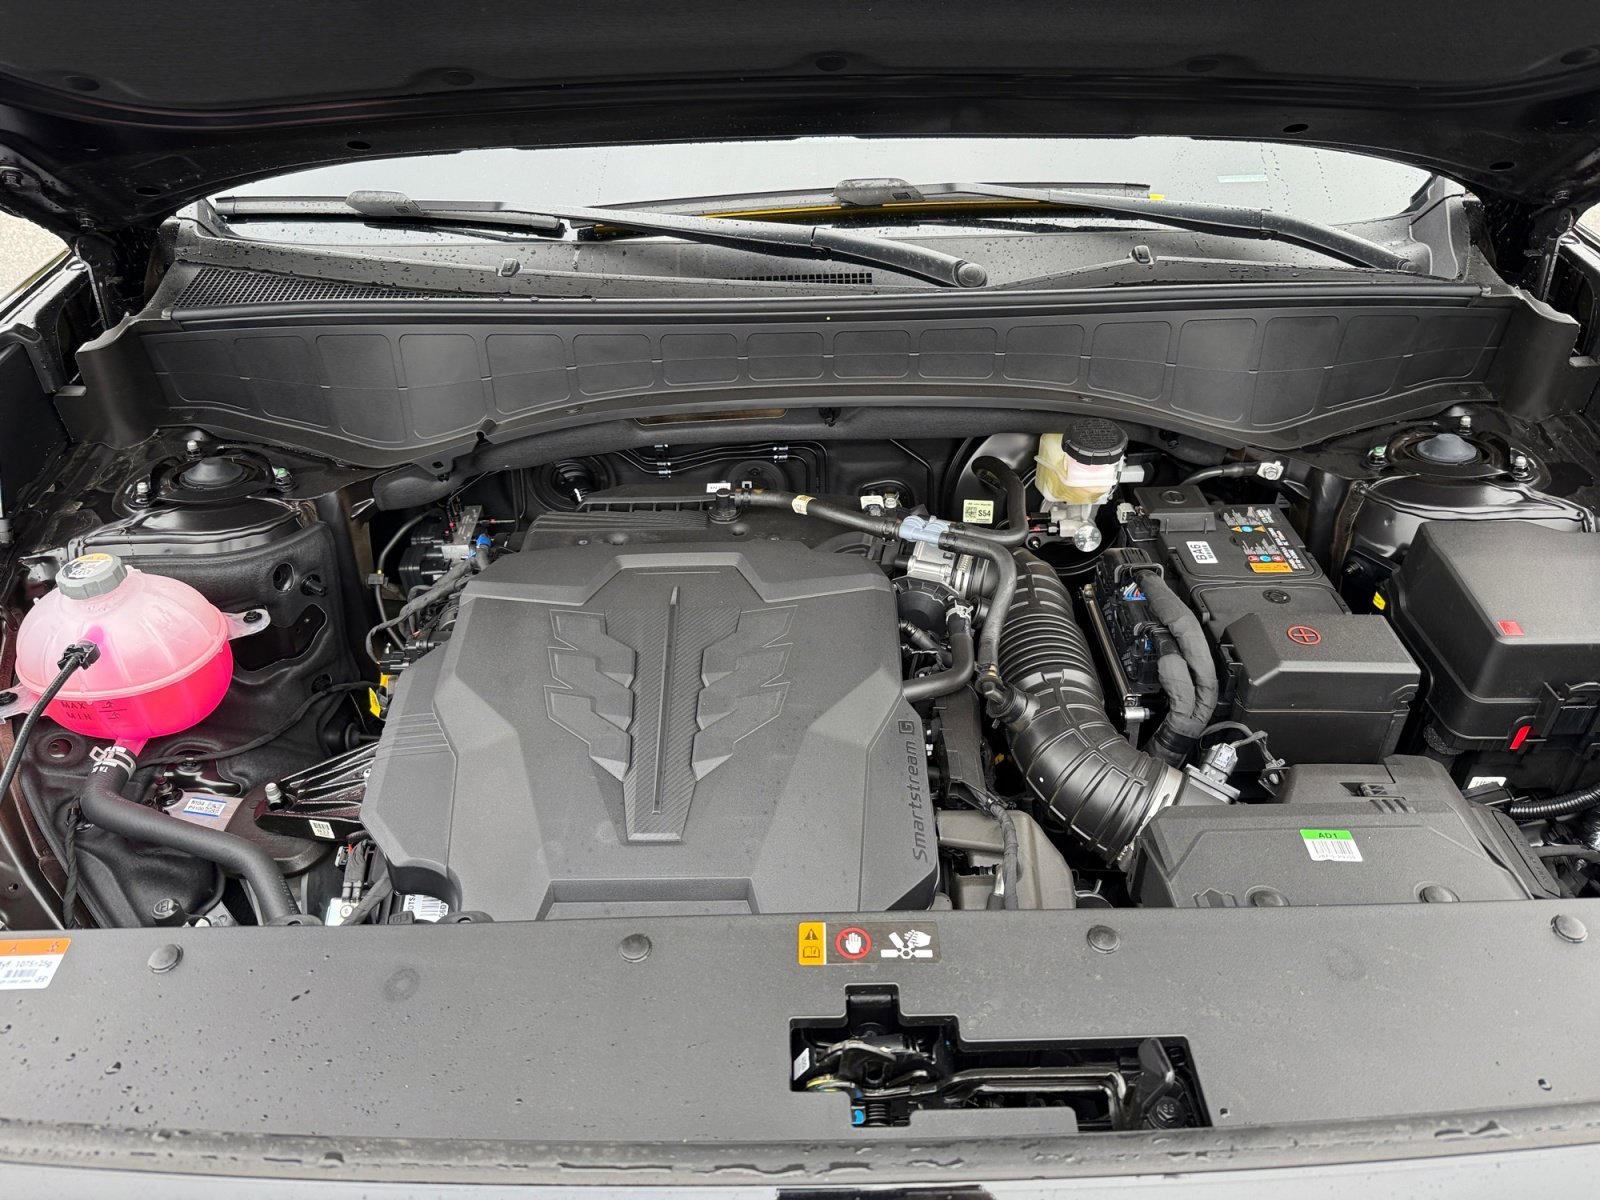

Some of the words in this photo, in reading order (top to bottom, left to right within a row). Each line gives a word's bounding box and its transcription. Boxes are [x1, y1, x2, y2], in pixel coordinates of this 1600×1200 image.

[977, 509, 991, 517] S54
[1190, 543, 1207, 561] BA6
[60, 701, 86, 709] MAX
[66, 711, 92, 720] MIN
[906, 740, 928, 863] Smartstream
